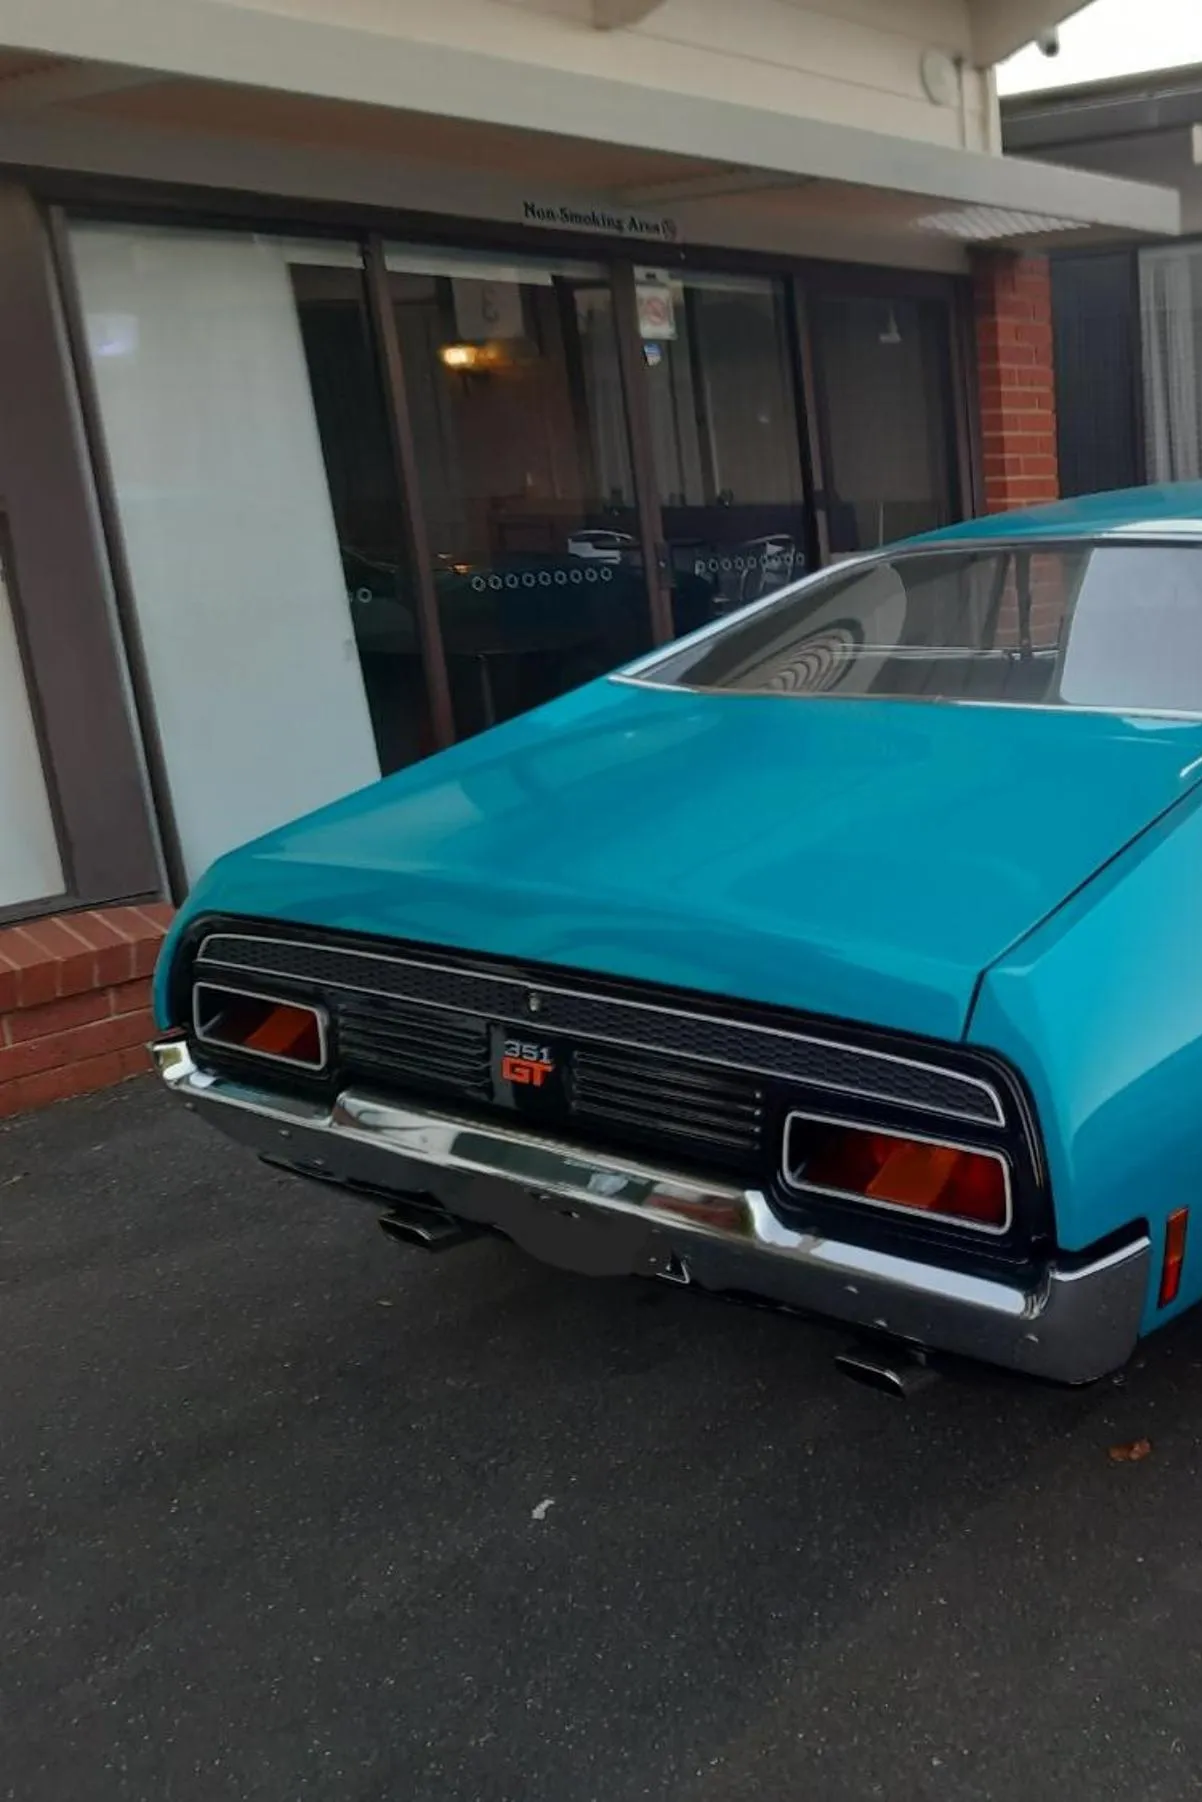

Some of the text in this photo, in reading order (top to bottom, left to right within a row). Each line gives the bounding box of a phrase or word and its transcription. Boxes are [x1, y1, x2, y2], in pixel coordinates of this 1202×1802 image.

[523, 201, 661, 233] Non-Smoking Area
[504, 1040, 551, 1064] 351
[502, 1056, 555, 1087] GT
